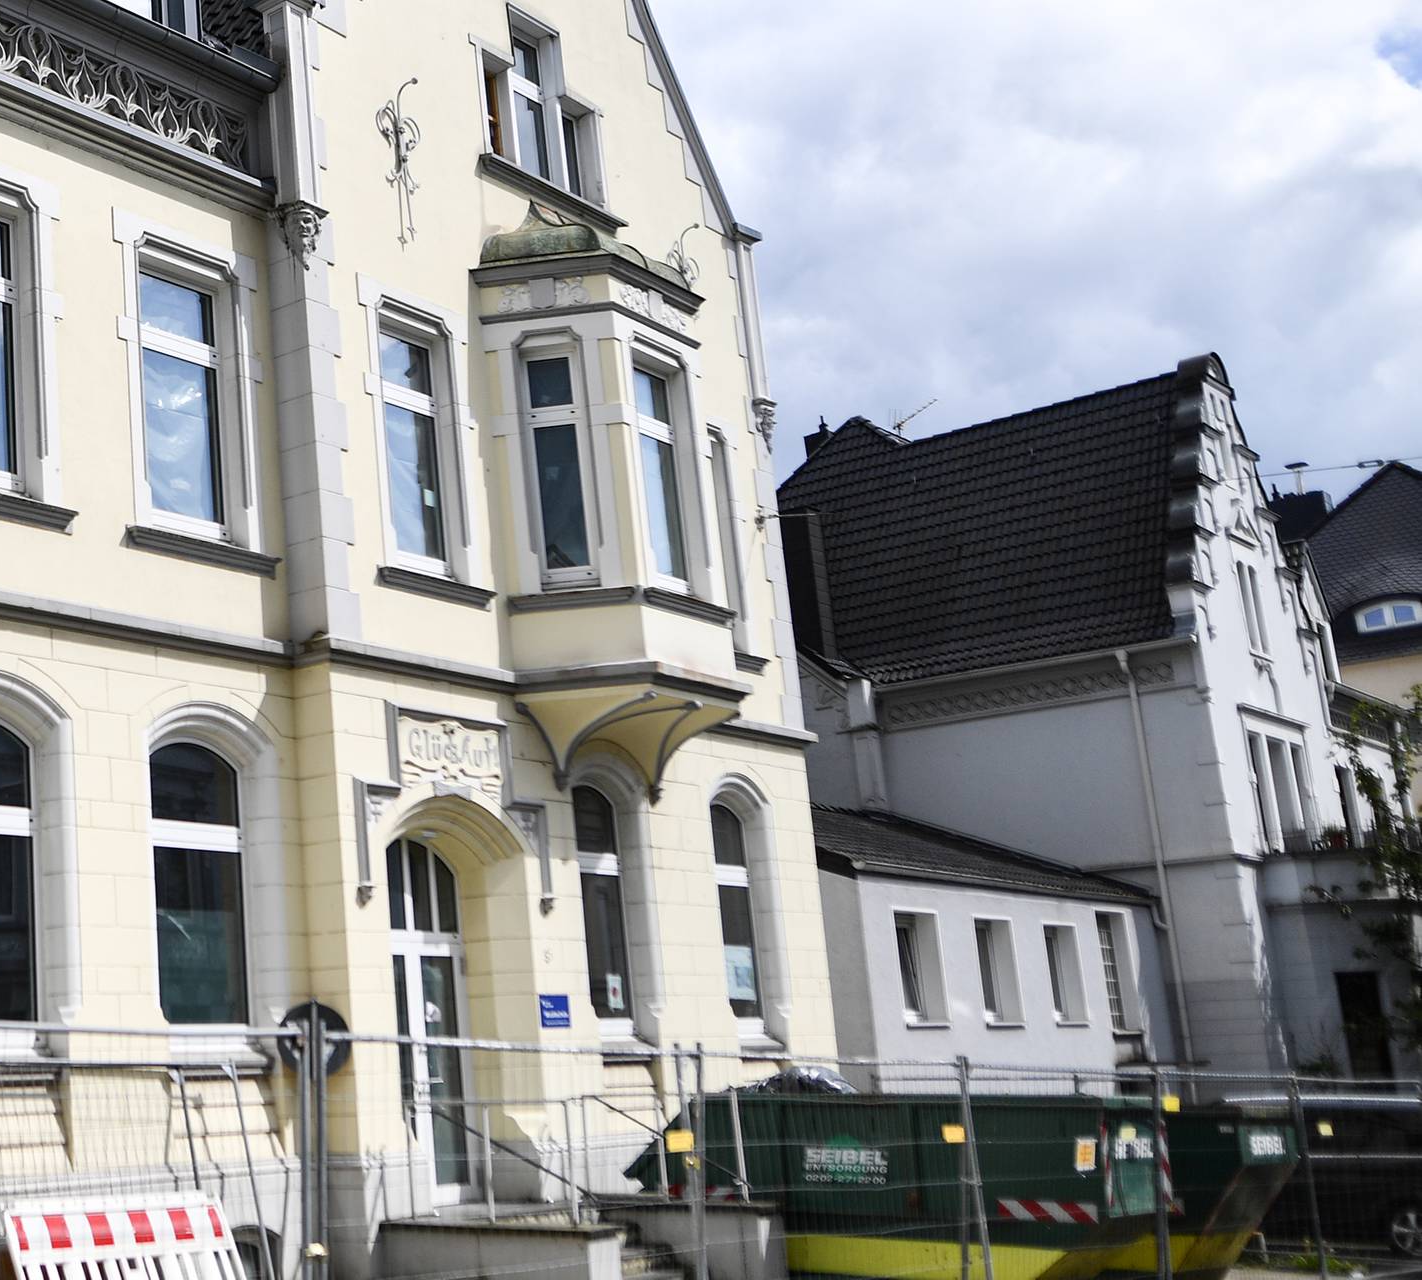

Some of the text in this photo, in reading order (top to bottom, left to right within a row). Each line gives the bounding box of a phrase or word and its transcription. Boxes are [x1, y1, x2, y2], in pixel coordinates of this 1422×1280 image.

[1250, 1134, 1286, 1156] SEIBEL
[804, 1147, 888, 1166] SEIBEL
[805, 1163, 888, 1174] ENTSORGUNG
